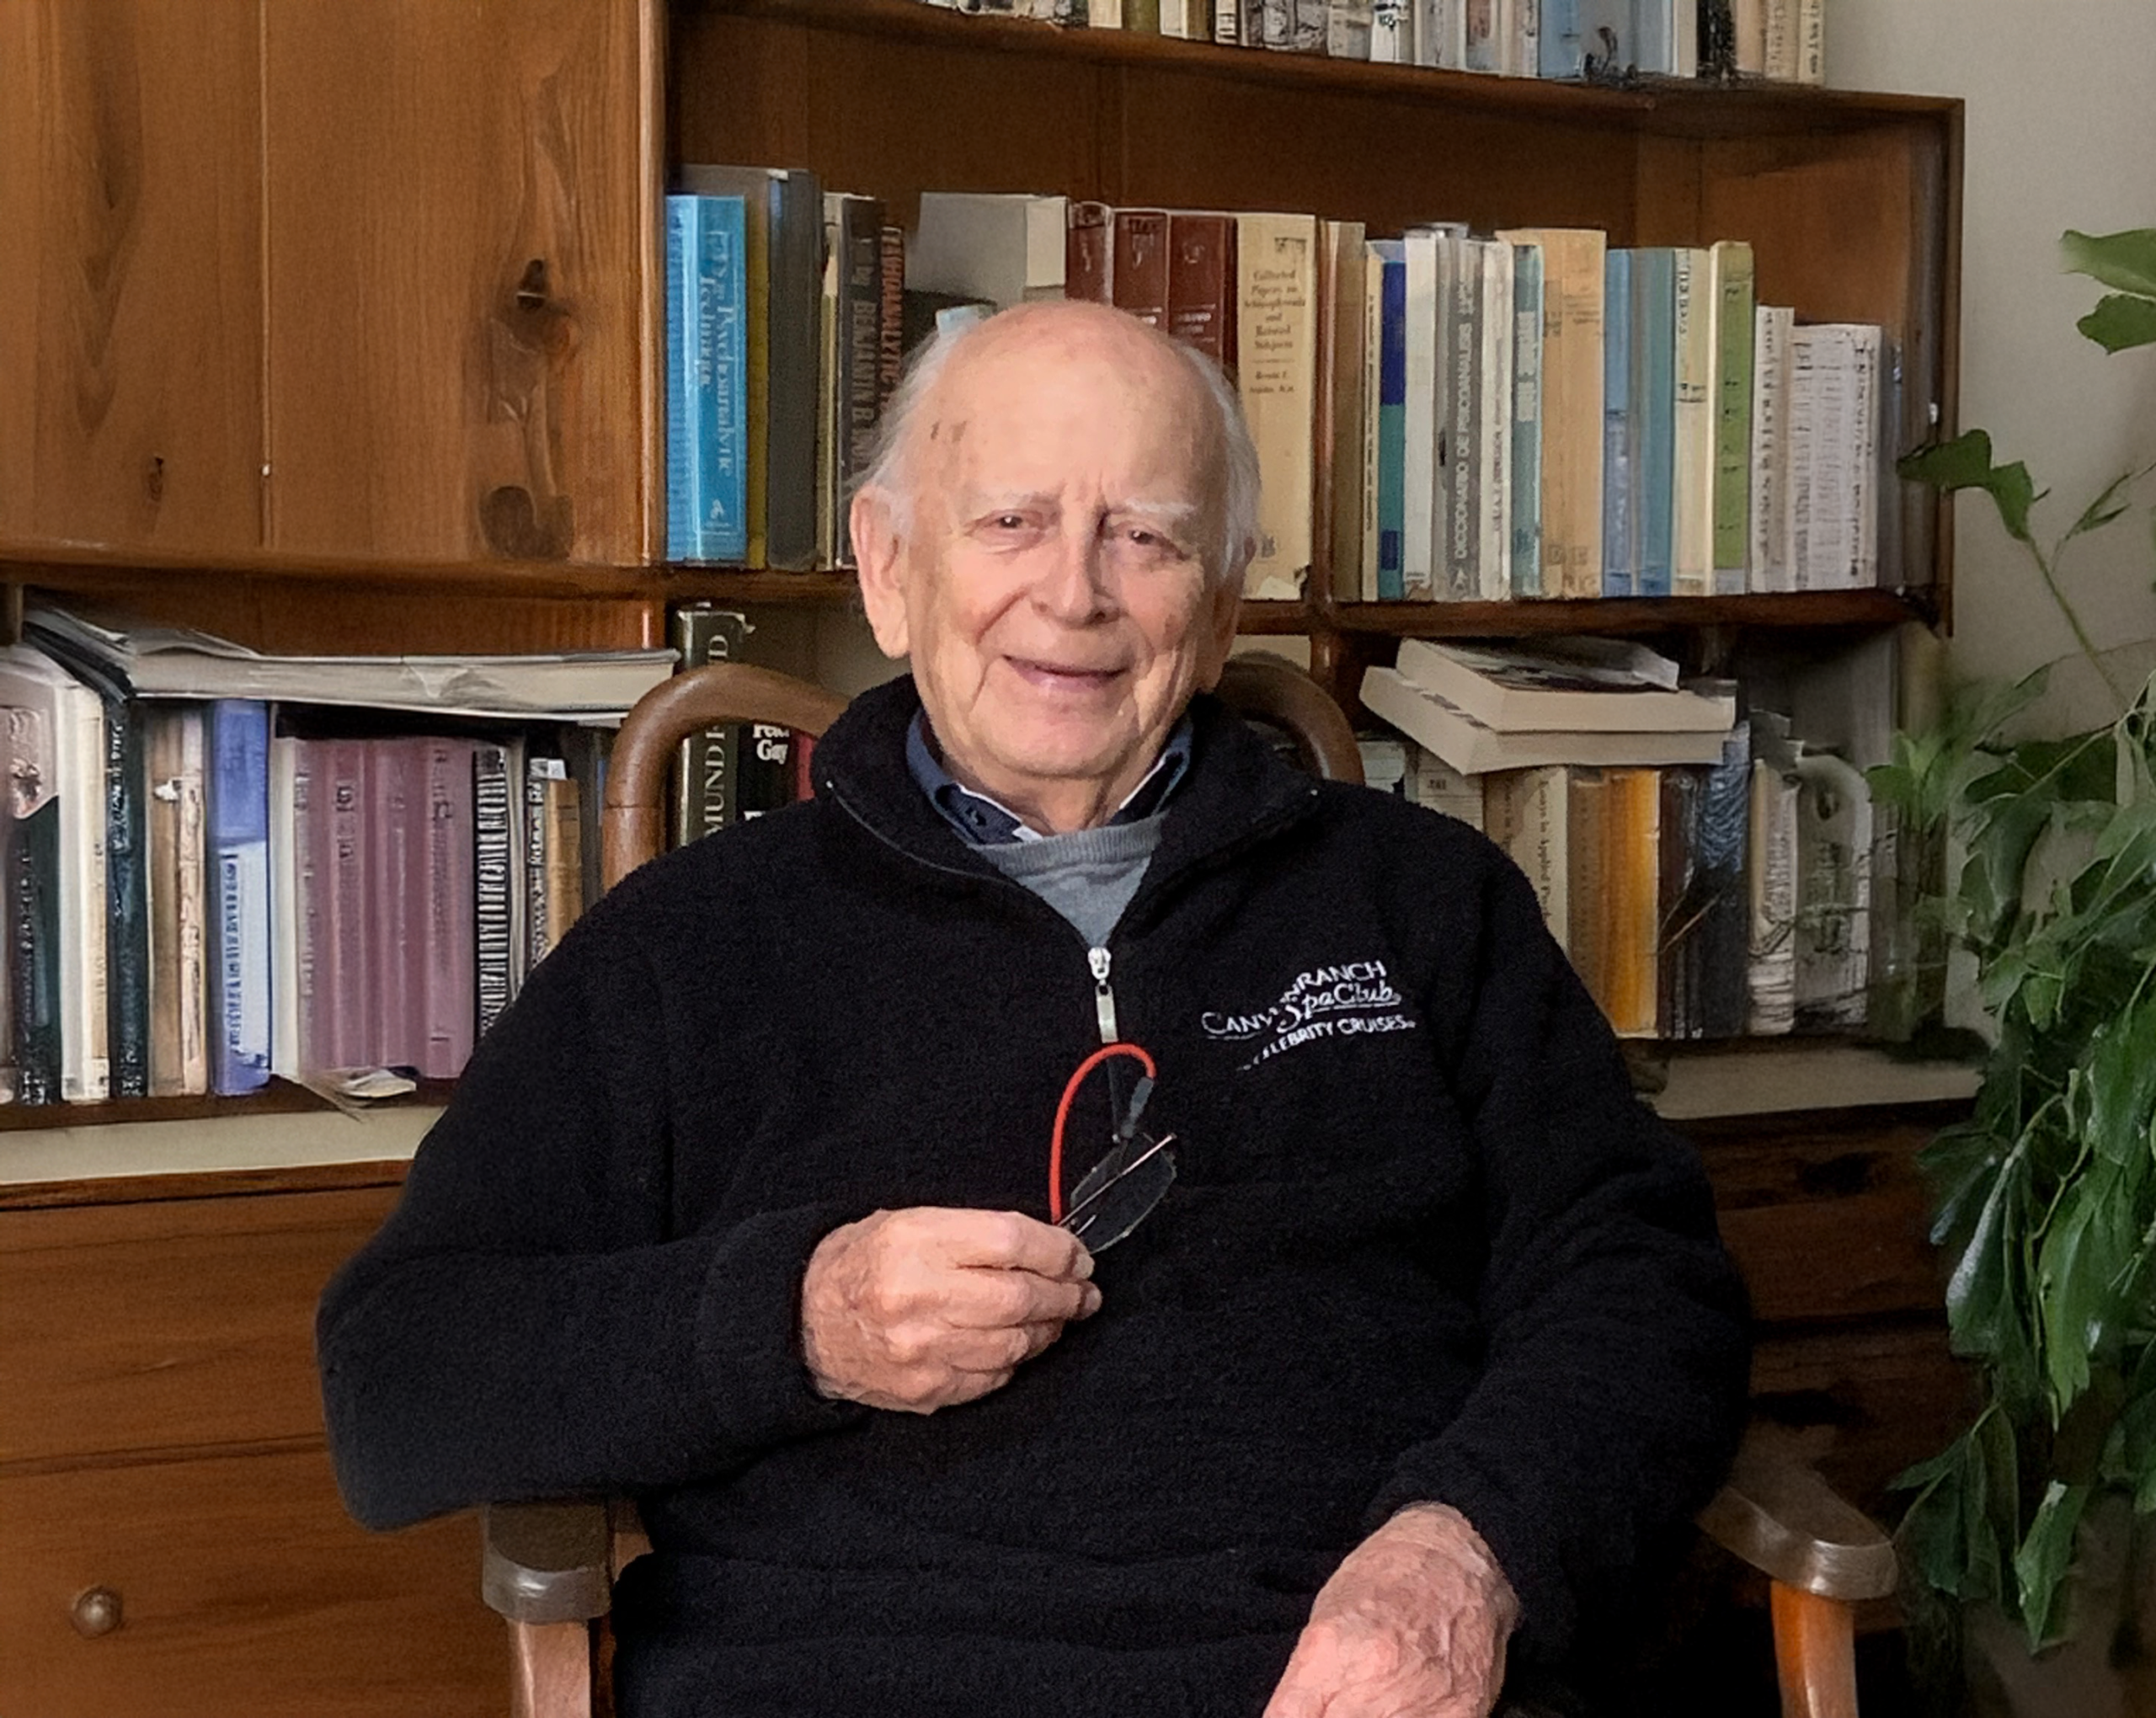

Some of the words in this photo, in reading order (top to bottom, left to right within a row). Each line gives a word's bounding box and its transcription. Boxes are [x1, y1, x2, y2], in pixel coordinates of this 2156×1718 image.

[704, 744, 725, 837] MUND
[1297, 960, 1387, 990] RANCH
[1337, 1014, 1407, 1034] CRUISES
